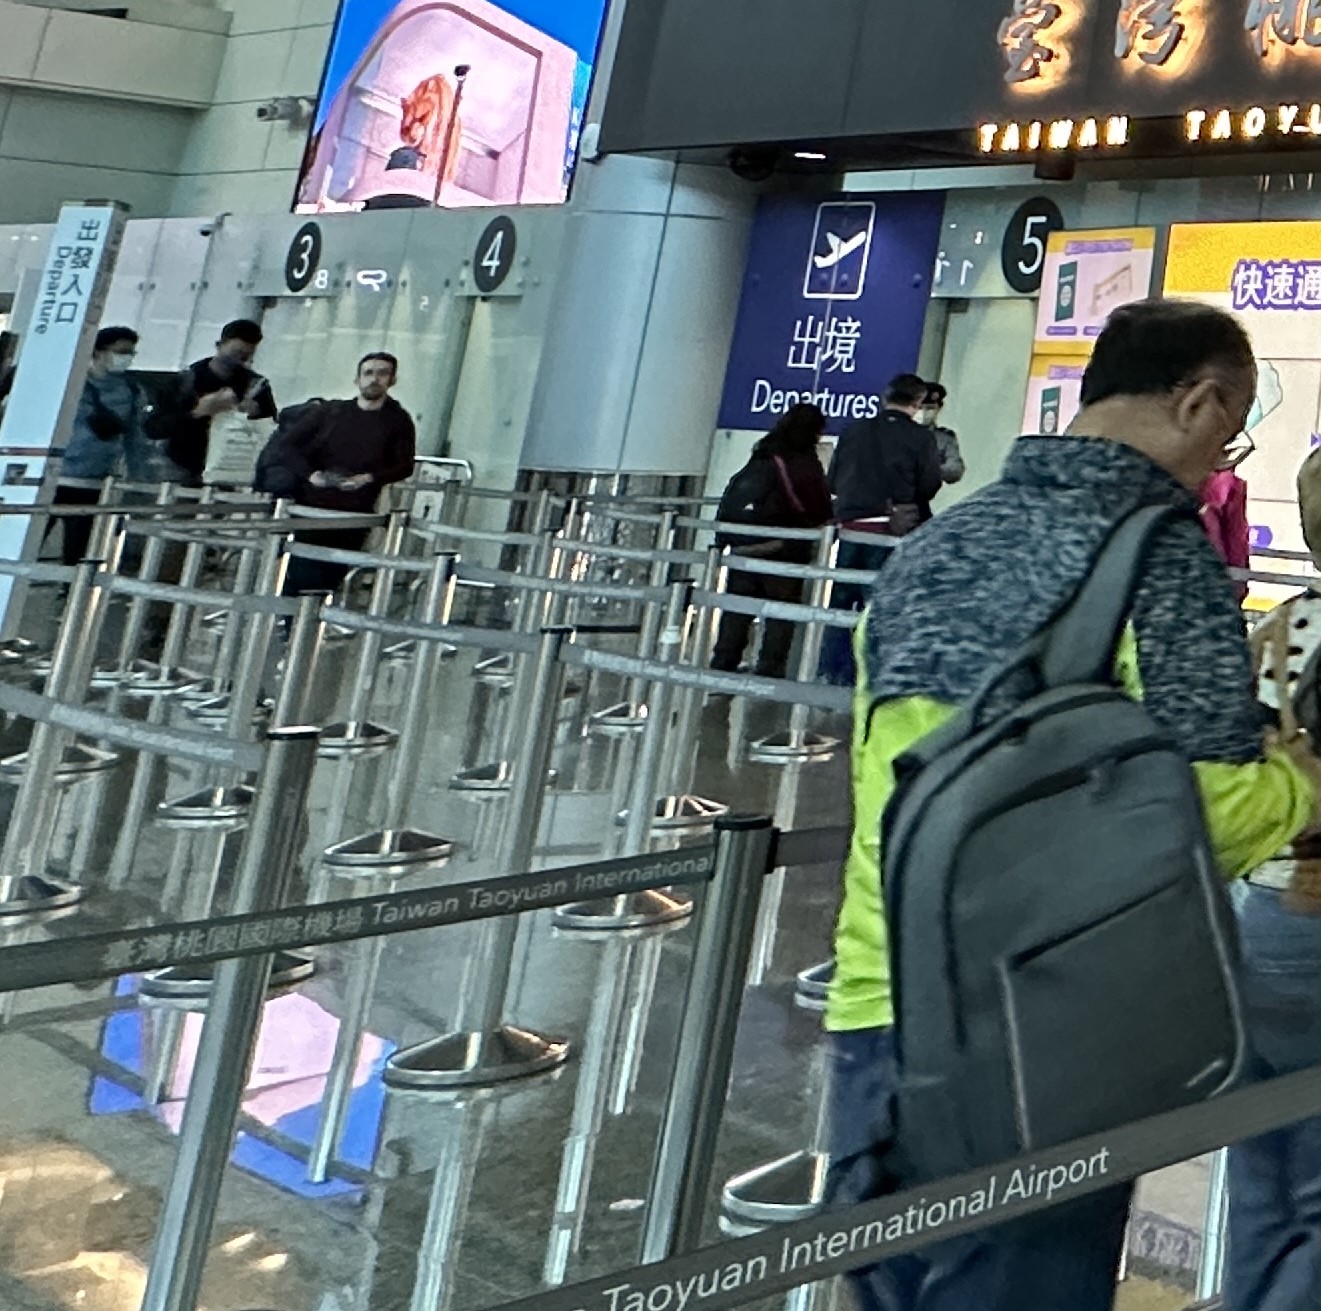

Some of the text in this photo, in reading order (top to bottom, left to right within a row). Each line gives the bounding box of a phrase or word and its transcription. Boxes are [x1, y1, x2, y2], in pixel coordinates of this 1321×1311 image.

[979, 116, 1129, 154] TAIWAN
[54, 219, 100, 324] 出發入口
[293, 235, 312, 279] 3
[481, 231, 502, 277] 4
[1018, 215, 1047, 275] 5
[34, 246, 73, 334] Departure
[787, 315, 861, 373] 出境
[372, 898, 459, 925] Taiwan
[468, 878, 568, 909] Taoyuan
[574, 854, 714, 893] International
[602, 1149, 1110, 1311] Taoyuan International Airport
